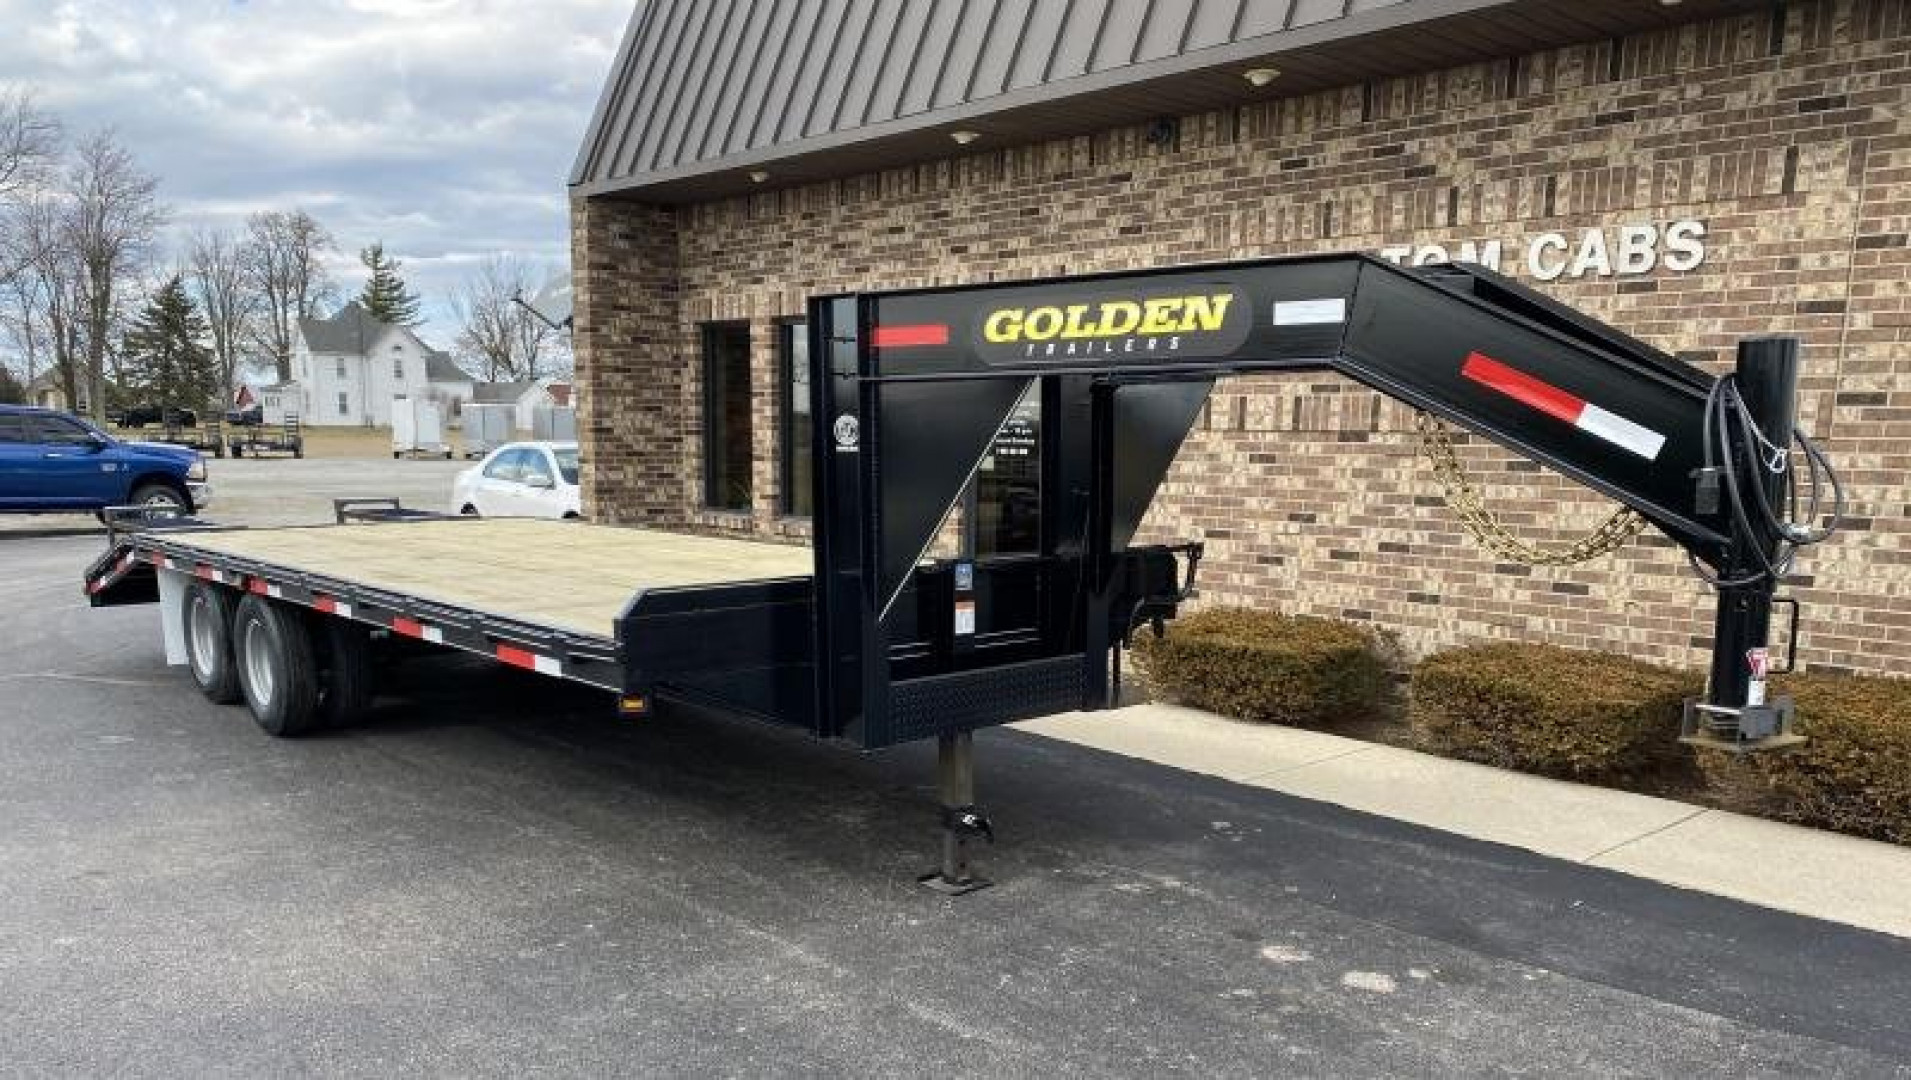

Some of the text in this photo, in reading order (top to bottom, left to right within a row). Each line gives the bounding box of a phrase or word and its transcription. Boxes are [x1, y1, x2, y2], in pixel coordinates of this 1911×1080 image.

[1528, 221, 1704, 281] CABS
[983, 294, 1233, 343] GOLDEN
[1025, 336, 1180, 357] TRAILERS
